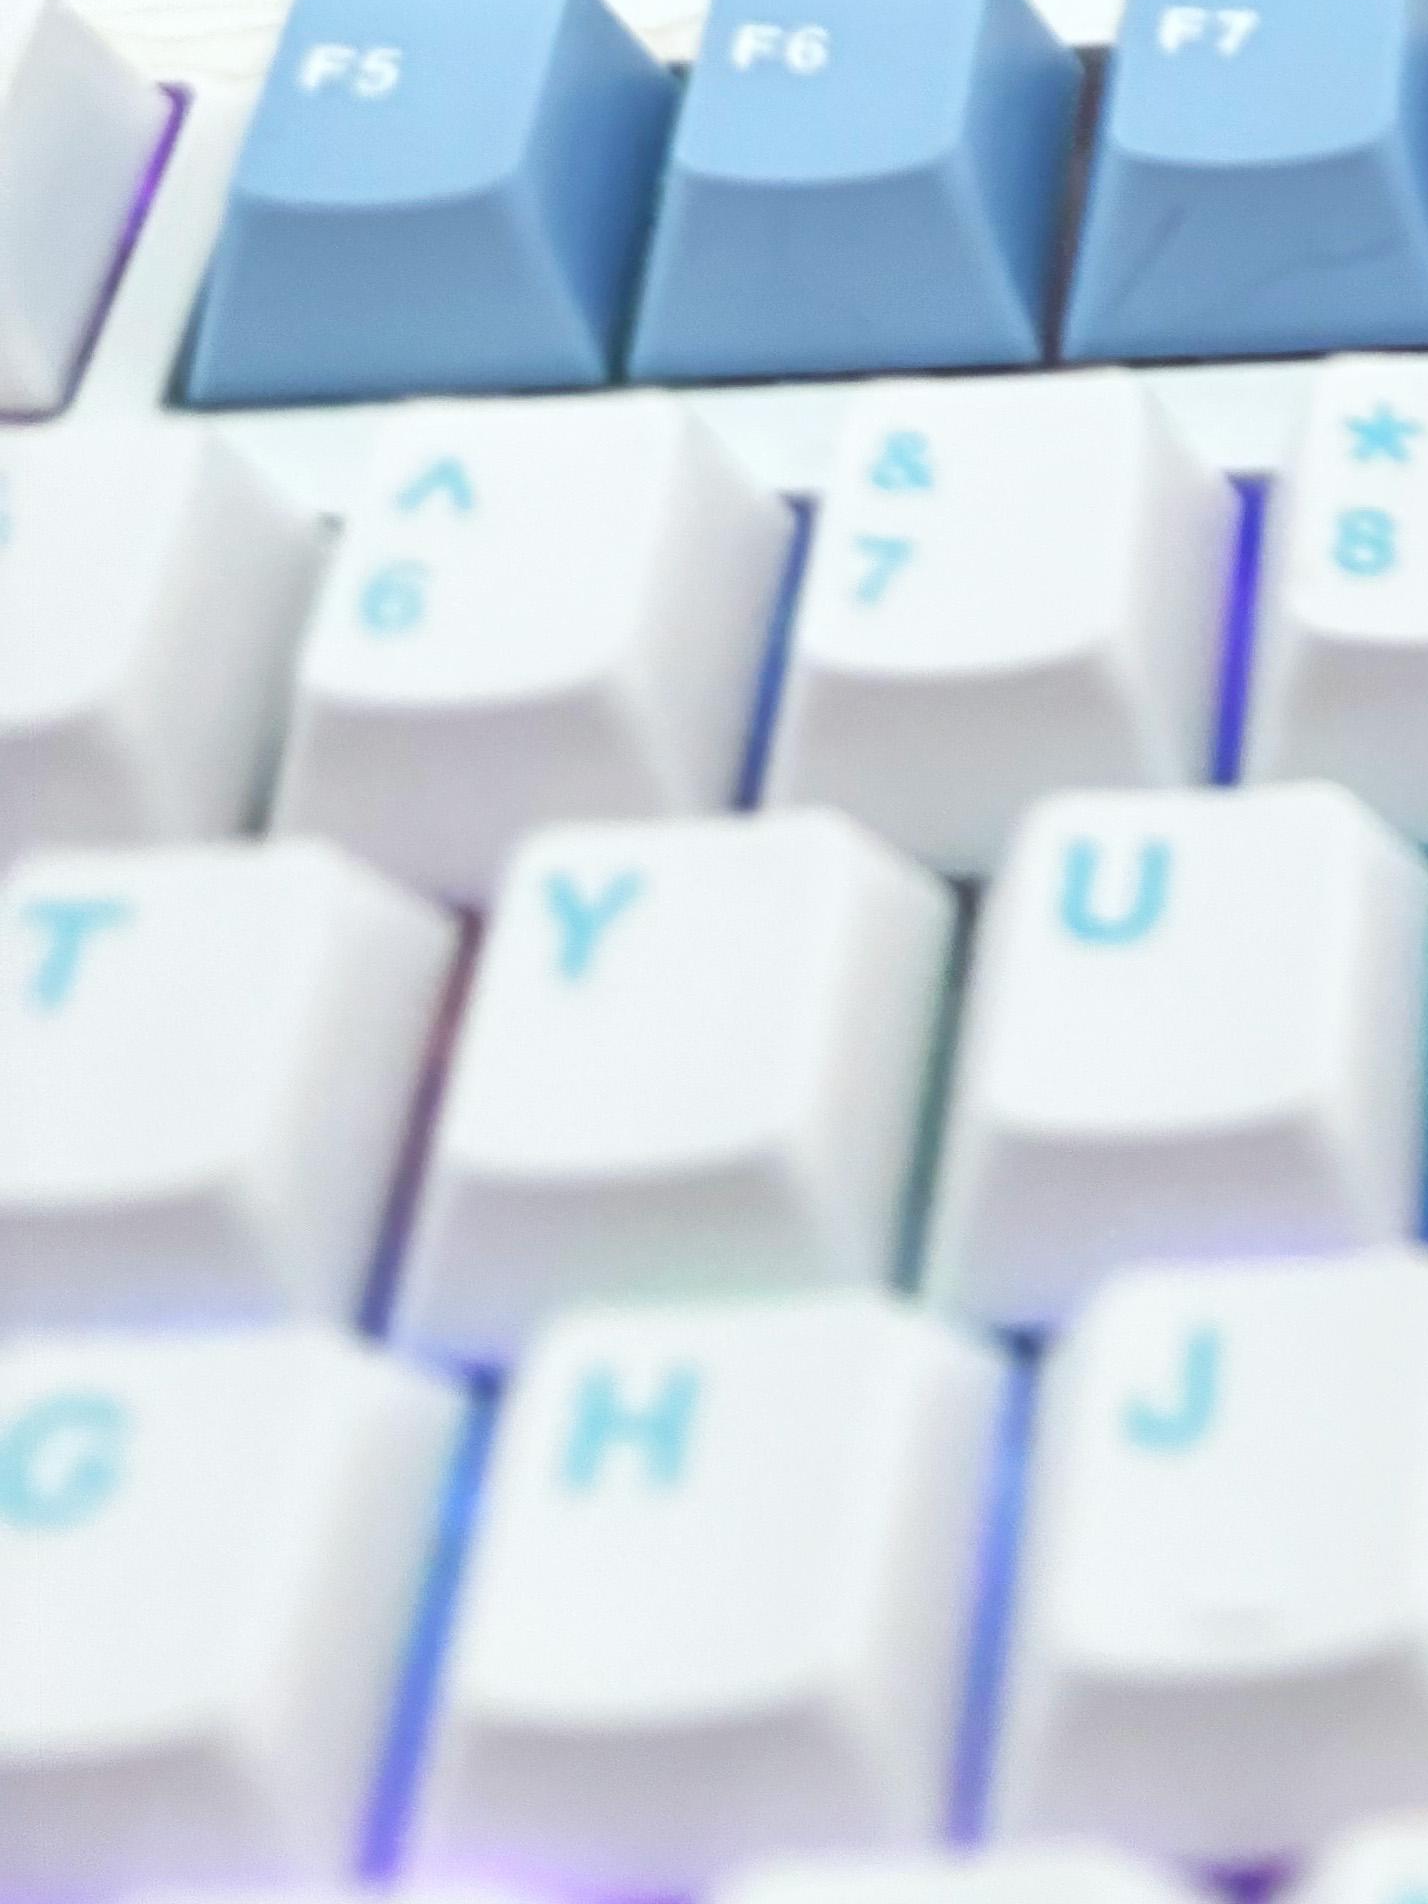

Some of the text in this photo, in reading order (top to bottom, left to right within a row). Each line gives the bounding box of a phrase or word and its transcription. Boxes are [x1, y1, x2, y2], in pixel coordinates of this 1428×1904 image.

[731, 23, 827, 73] F6
[1158, 7, 1258, 55] F7
[299, 44, 400, 97] F5
[869, 432, 934, 492] &
[855, 535, 914, 606] 7
[1332, 508, 1397, 577] 8
[357, 562, 424, 636] 6
[546, 875, 640, 981] Y
[1058, 840, 1172, 947] U
[23, 899, 128, 1010] T
[1121, 1326, 1224, 1455] J
[0, 1393, 128, 1531] G
[562, 1369, 700, 1489] H
